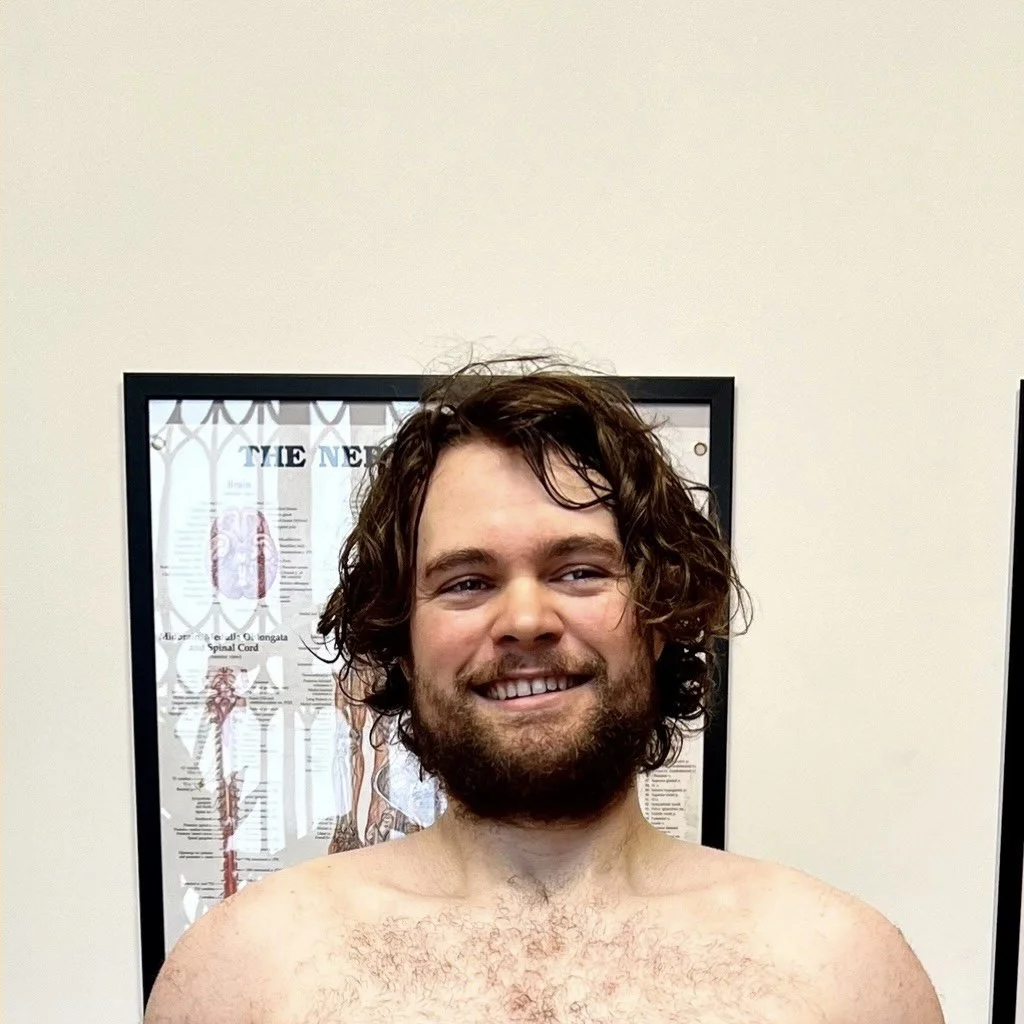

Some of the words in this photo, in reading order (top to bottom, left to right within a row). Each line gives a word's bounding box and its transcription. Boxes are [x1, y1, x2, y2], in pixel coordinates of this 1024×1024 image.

[238, 445, 306, 467] THE
[208, 643, 235, 653] Spinal
[238, 643, 259, 651] Cord
